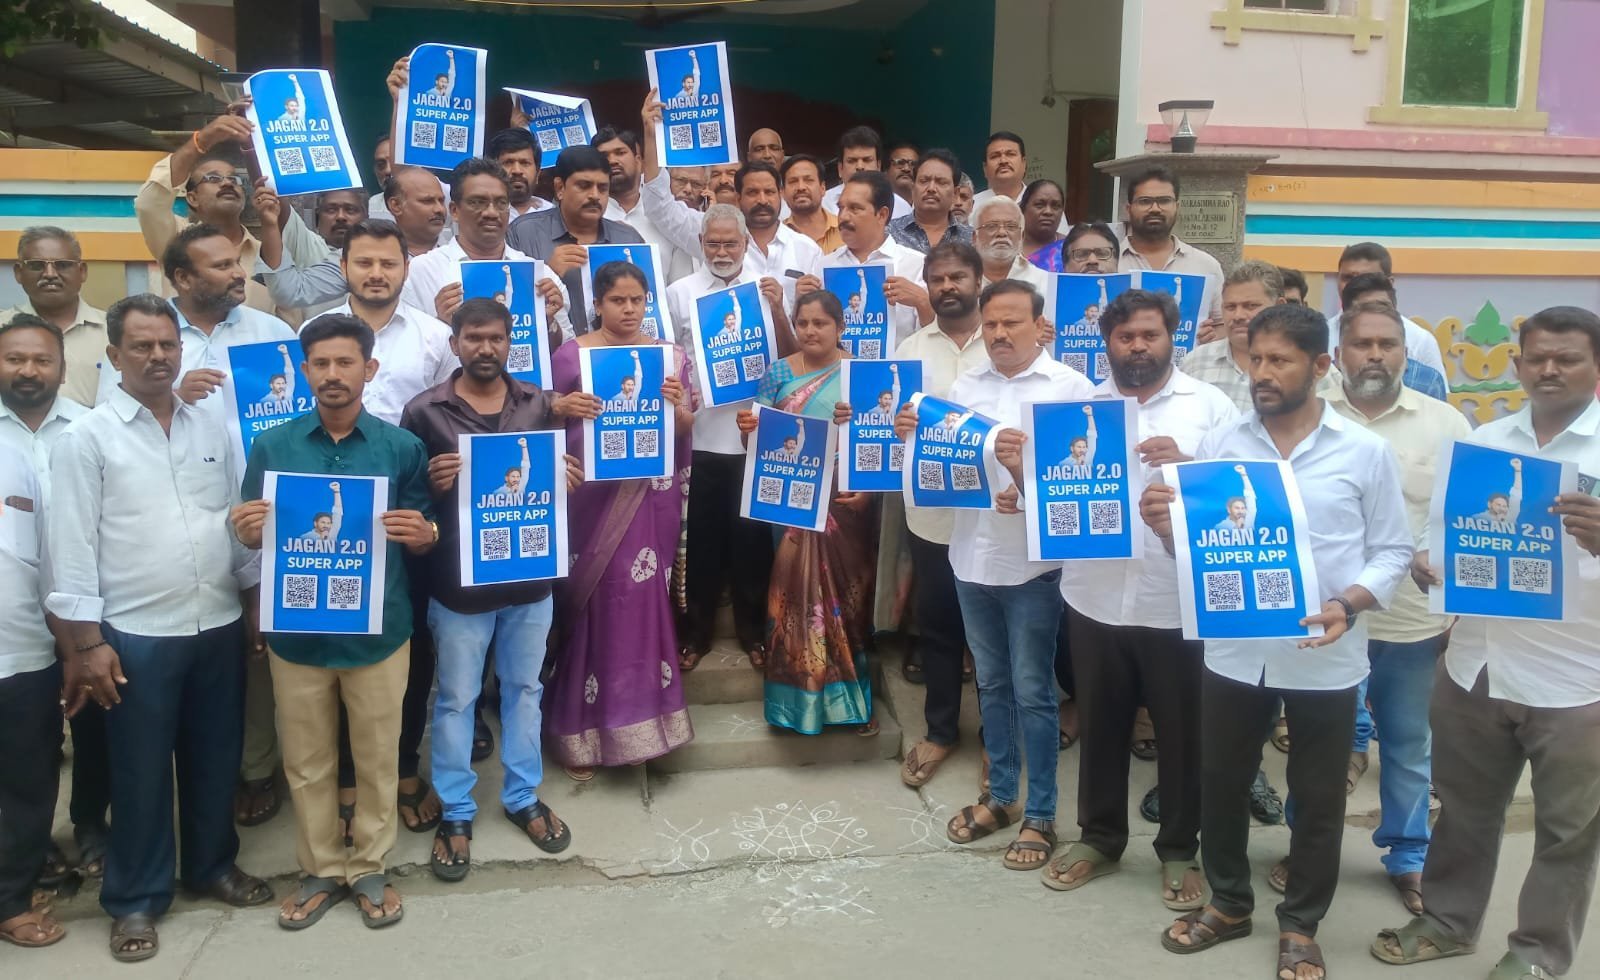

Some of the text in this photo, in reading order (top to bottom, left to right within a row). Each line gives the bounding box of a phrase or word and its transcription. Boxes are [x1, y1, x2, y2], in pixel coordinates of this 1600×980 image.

[412, 92, 472, 111] JAGAN 2.0
[665, 93, 719, 110] JAGAN 2.0
[415, 108, 469, 122] SUPER APP
[530, 105, 561, 118] JAGAN
[670, 108, 719, 121] SUPER APP
[266, 118, 329, 133] JAGAN 2.0
[535, 114, 580, 128] SUPER APP
[273, 134, 330, 144] SUPER APP
[512, 314, 532, 327] 2.0
[844, 312, 884, 325] GAN 2.0
[510, 330, 530, 340] APP
[707, 326, 762, 349] JAGAN 2.0
[842, 327, 882, 336] PER APP
[1060, 324, 1101, 337] JAGAN
[712, 341, 762, 358] SUPER APP
[1063, 340, 1098, 348] SUPER
[244, 399, 294, 418] JAGAN
[602, 399, 660, 412] JAGAN 2.0
[602, 415, 658, 426] SUPER APP
[854, 413, 894, 426] JAGAN
[858, 429, 893, 438] SUPER
[920, 427, 981, 446] JAGAN 2.0
[761, 450, 820, 468] JAGAN 2.0
[922, 445, 976, 460] SUPER APP
[763, 463, 816, 478] SUPER APP
[1042, 463, 1122, 481] JAGAN 2.0
[1048, 483, 1119, 496] SUPER APP
[477, 490, 551, 509] JAGAN 2.0
[482, 509, 548, 523] SUPER APP
[1452, 516, 1555, 541] JAGAN 2.0
[1196, 526, 1288, 548] JAGAN 2.0
[1459, 534, 1552, 554] SUPER APP
[282, 537, 367, 555] JAGAN 2.0
[287, 557, 363, 570] SUPER APP
[1205, 549, 1288, 565] SUPER APP
